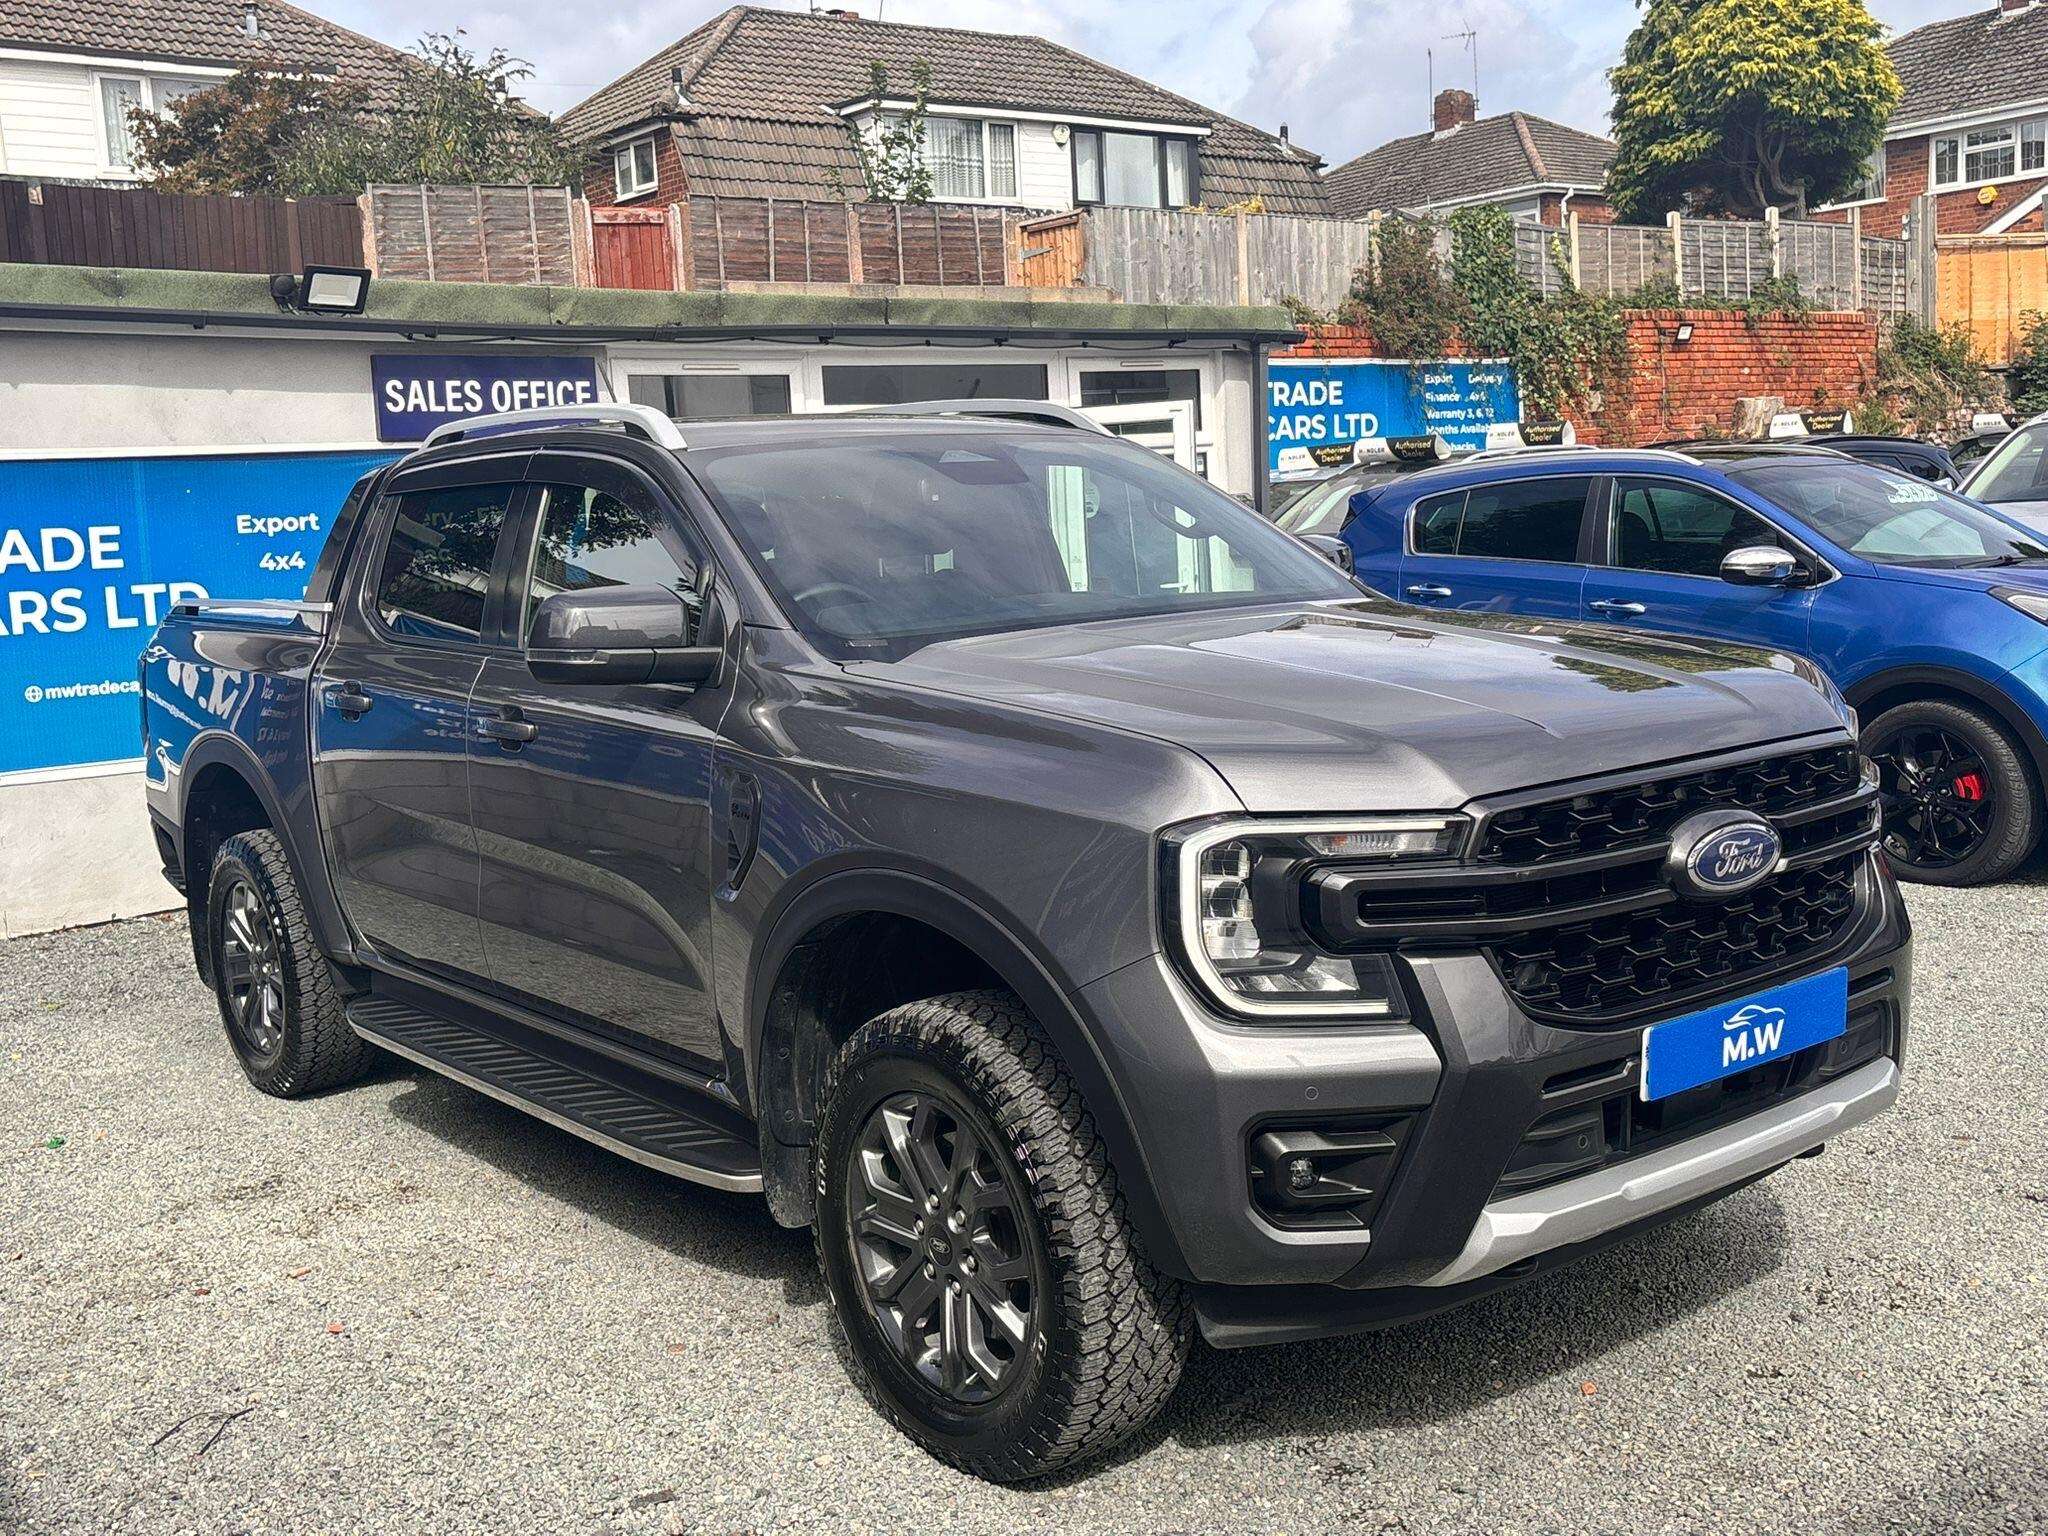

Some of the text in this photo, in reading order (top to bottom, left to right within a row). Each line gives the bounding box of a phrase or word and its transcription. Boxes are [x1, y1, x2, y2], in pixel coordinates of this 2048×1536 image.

[385, 379, 591, 413] SALES OFFICE
[1268, 380, 1343, 407] RADE
[1334, 412, 1378, 439] LTD
[1427, 408, 1466, 420] Warranty
[1316, 445, 1351, 456] Authorised
[1394, 439, 1432, 450] Authorised
[1321, 454, 1343, 463] Dealer
[236, 512, 320, 537] Export
[259, 551, 306, 571] 4x4
[0, 587, 87, 636] RS
[45, 679, 140, 700] mwtradeca
[1714, 837, 1764, 878] Ford
[1722, 1018, 1785, 1068] M.W
